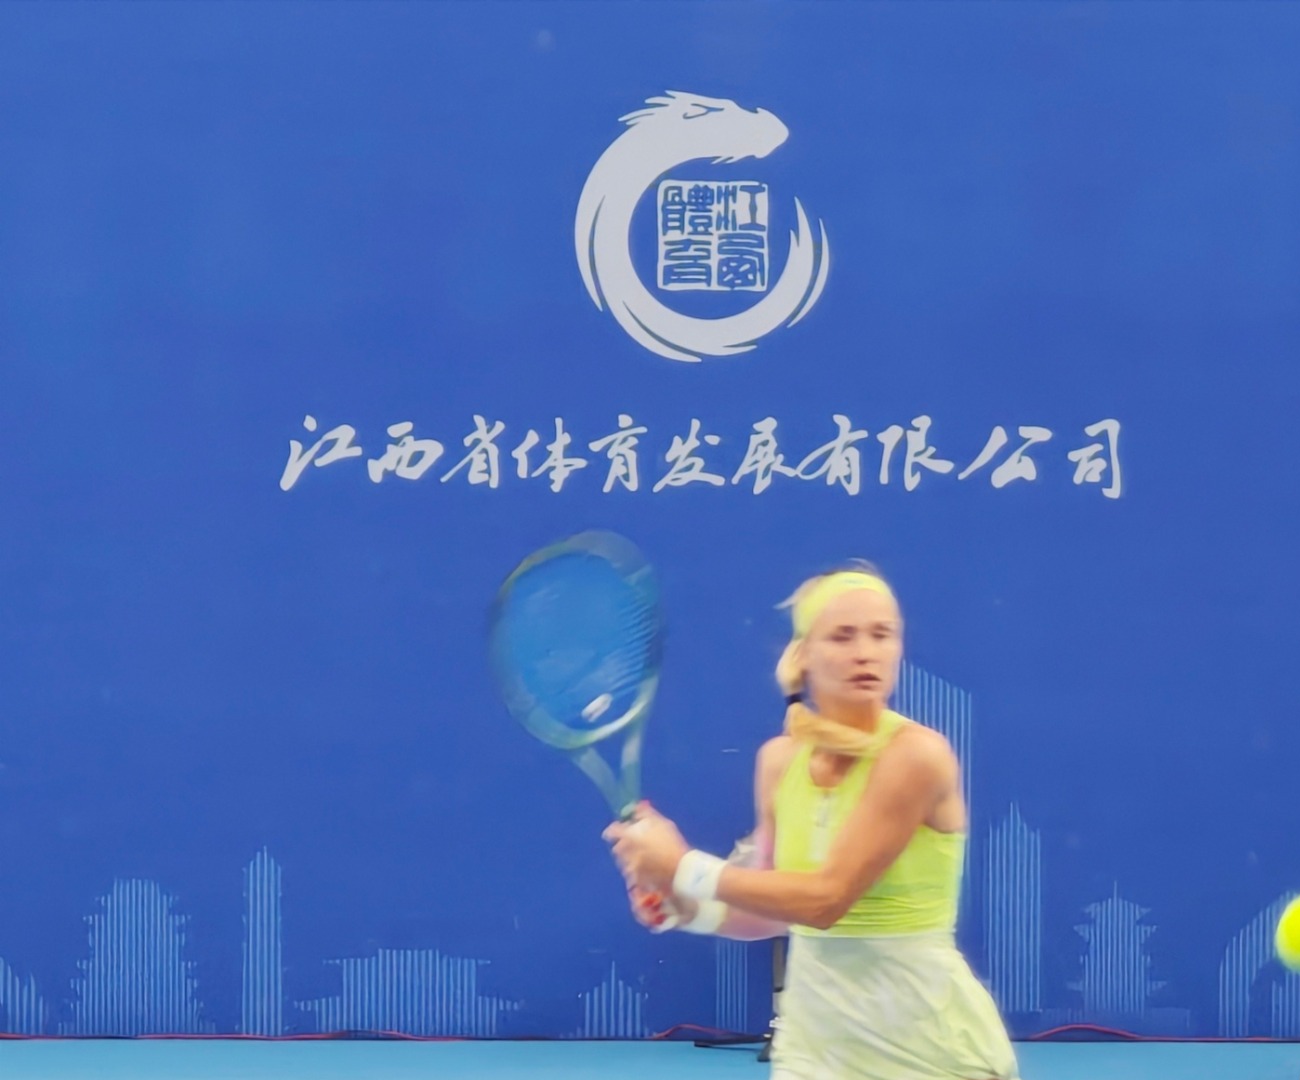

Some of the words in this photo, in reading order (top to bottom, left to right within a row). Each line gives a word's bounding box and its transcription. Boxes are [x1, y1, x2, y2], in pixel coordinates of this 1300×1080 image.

[279, 414, 1122, 499] 江西省体育发展有限公司
